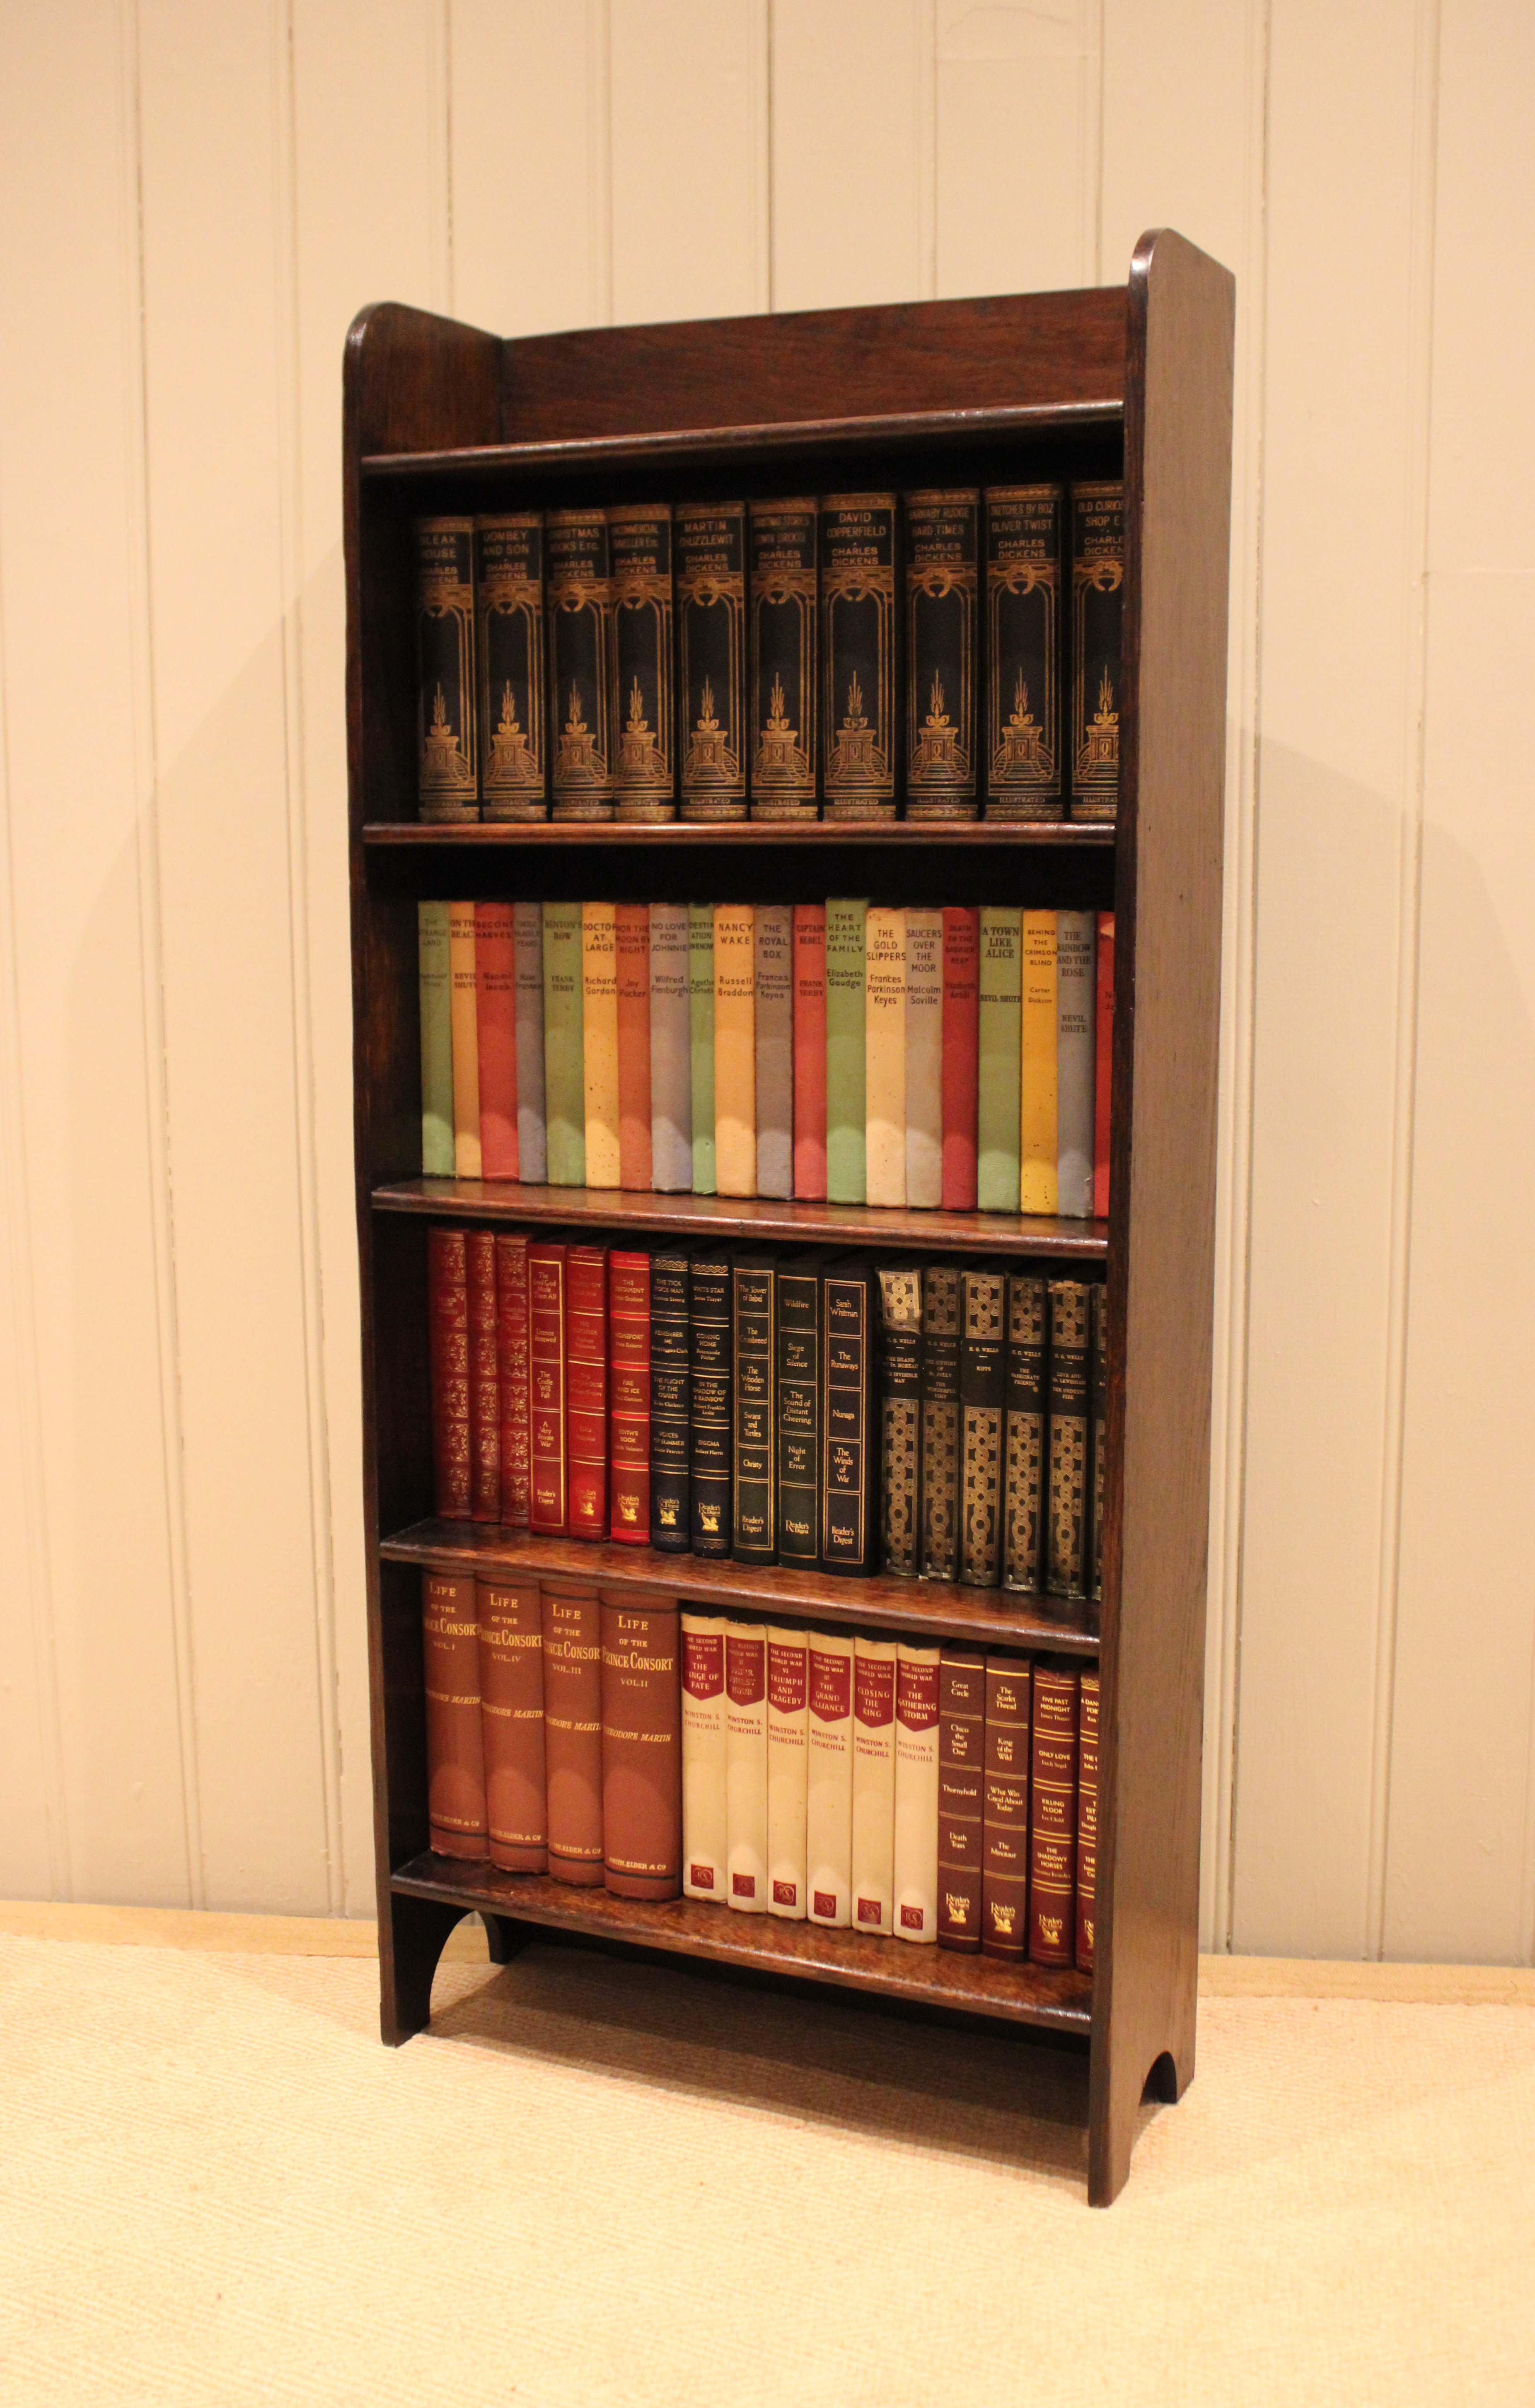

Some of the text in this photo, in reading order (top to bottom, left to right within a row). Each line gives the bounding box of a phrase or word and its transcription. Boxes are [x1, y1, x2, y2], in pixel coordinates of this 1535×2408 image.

[839, 513, 871, 523] DAVID
[684, 521, 726, 531] MARTIN
[937, 524, 964, 534] TIMES
[1024, 519, 1052, 530] TWIST
[827, 526, 886, 537] COPPERFIELD
[915, 543, 961, 551] CHARLES
[998, 539, 1044, 548] CHARLES
[483, 544, 529, 556] AND SON
[832, 547, 878, 556] CHARLES
[998, 549, 1045, 559] DICKENS
[685, 554, 728, 563] CHARLES
[832, 557, 878, 566] DICKENS
[915, 553, 962, 562] DICKENS
[685, 563, 729, 572] DICKENS
[759, 560, 802, 570] DICKENS
[906, 930, 942, 938] SAUCERS
[991, 927, 1019, 936] TOWN
[1064, 931, 1081, 940] THE
[759, 937, 788, 946] ROYAL
[989, 938, 1011, 947] LIKE
[867, 952, 906, 961] SLIPPERS
[985, 949, 1014, 958] ALICE
[827, 969, 863, 977] Elizabeth
[912, 964, 936, 973] MOOR
[1061, 968, 1085, 977] ROSE
[720, 976, 752, 985] Russell
[829, 979, 861, 989] Goudge
[875, 996, 897, 1007] Keyes
[911, 996, 938, 1005] Saville
[1061, 1025, 1087, 1033] SHUTE
[784, 1299, 809, 1308] Wildfire
[836, 1299, 851, 1308] Sarah
[831, 1307, 858, 1317] Whitman
[788, 1343, 804, 1352] Siege
[838, 1352, 851, 1360] The
[786, 1359, 807, 1367] Silence
[831, 1360, 858, 1371] Runaways
[742, 1375, 764, 1383] Wooden
[745, 1384, 761, 1392] Horse
[784, 1398, 803, 1406] Sound
[787, 1406, 808, 1415] Distant
[744, 1412, 761, 1420] Swans
[783, 1414, 811, 1425] Cheering
[744, 1429, 761, 1437] Turtles
[788, 1446, 805, 1455] Night
[836, 1447, 849, 1456] The
[743, 1459, 762, 1469] Christy
[833, 1456, 853, 1465] Winds
[789, 1461, 805, 1470] Error
[839, 1465, 846, 1474] of
[837, 1474, 850, 1483] War
[743, 1524, 762, 1533] Digest
[834, 1535, 853, 1546] Digest
[490, 1593, 518, 1608] LIFE
[553, 1604, 581, 1619] LIFE
[618, 1616, 648, 1630] LIFE
[603, 1646, 673, 1671] PRINCE CONSORT
[771, 1674, 803, 1686] TRIUMPH
[820, 1682, 834, 1691] THE
[952, 1680, 969, 1690] Great
[858, 1687, 890, 1698] CLOSING
[951, 1688, 969, 1697] Circle
[1000, 1686, 1012, 1695] The
[771, 1693, 802, 1705] TRAGEDY
[816, 1691, 839, 1702] GRAND
[907, 1691, 922, 1700] THE
[865, 1698, 878, 1708] THE
[898, 1699, 936, 1711] GATHERING
[996, 1700, 1017, 1710] Thread
[863, 1708, 881, 1717] RING
[1040, 1703, 1070, 1713] MIDNIGHT
[904, 1710, 928, 1720] STORM
[950, 1724, 969, 1733] Chico
[952, 1740, 967, 1749] Small
[998, 1737, 1013, 1747] King
[856, 1746, 890, 1757] CHURCHILL
[952, 1748, 966, 1756] One
[1039, 1750, 1054, 1758] ONLY
[997, 1752, 1012, 1762] Wild
[943, 1784, 977, 1797] Thornyhold
[991, 1786, 1020, 1797] What Was
[1042, 1798, 1065, 1807] KILLING
[950, 1832, 967, 1841] Death
[998, 1842, 1010, 1850] The
[1037, 1852, 1067, 1863] SHADOWY
